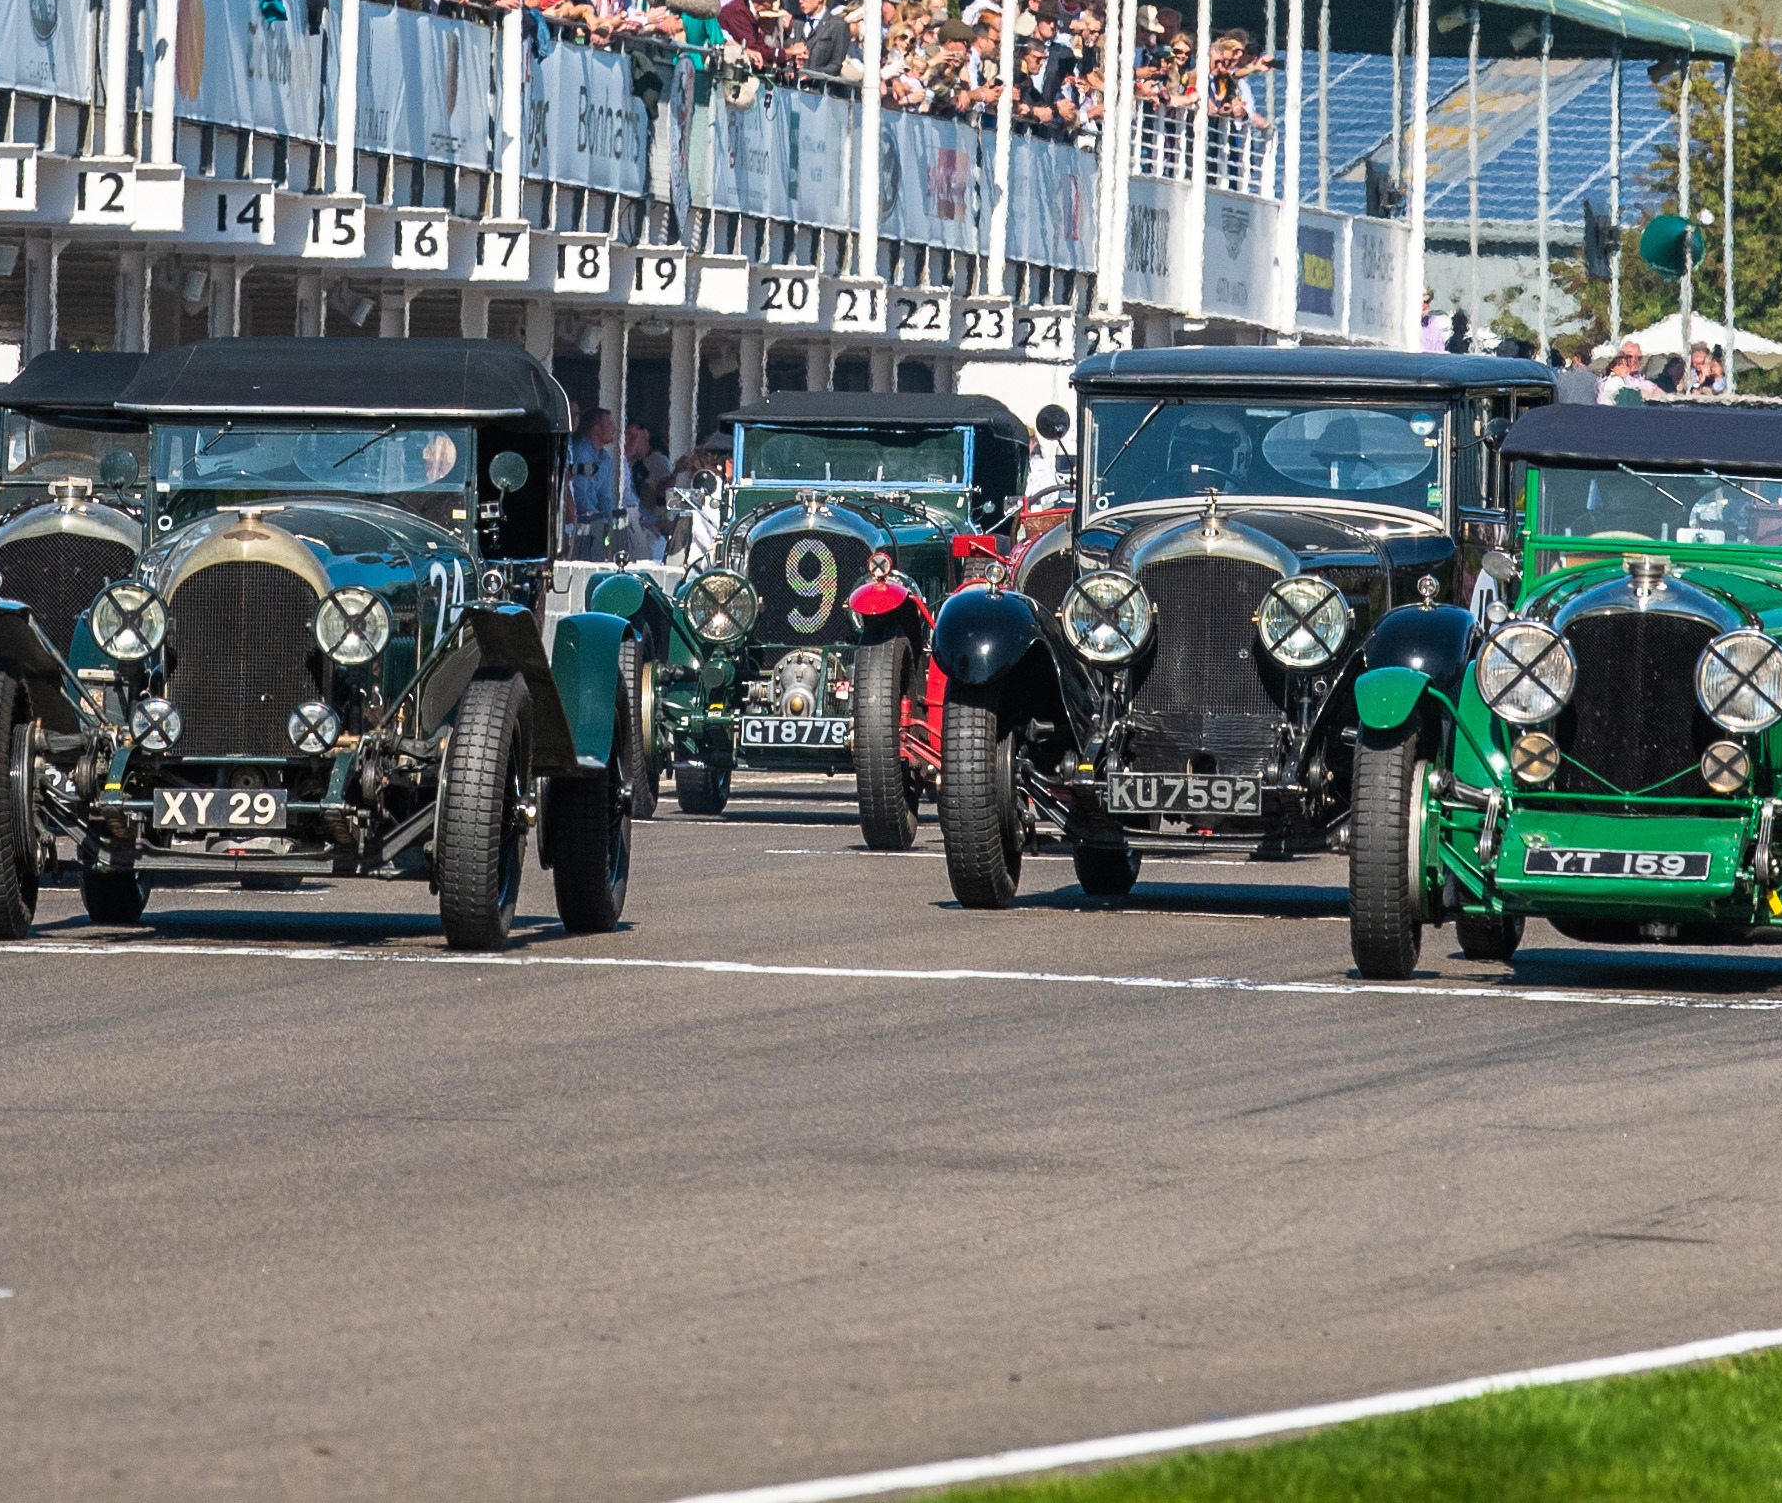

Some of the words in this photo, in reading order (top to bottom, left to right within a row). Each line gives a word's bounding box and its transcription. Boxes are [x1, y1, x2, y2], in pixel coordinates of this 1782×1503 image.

[78, 172, 124, 212] 12
[217, 193, 263, 233] 14
[313, 207, 356, 246] 15
[394, 220, 438, 257] 16
[476, 231, 522, 267] 17
[557, 243, 599, 279] 18
[635, 256, 677, 291] 19
[760, 277, 808, 311] 20
[837, 289, 877, 321] 21
[895, 298, 940, 330] 22
[962, 308, 1003, 338] 23
[1017, 317, 1061, 349] 24
[1084, 325, 1123, 356] 25
[785, 538, 838, 634] 9
[745, 718, 847, 745] GT8779
[160, 792, 215, 825] XY
[228, 792, 277, 825] 29
[1112, 777, 1257, 811] KU7592
[1551, 852, 1601, 873] YT
[1622, 854, 1686, 876] 159
